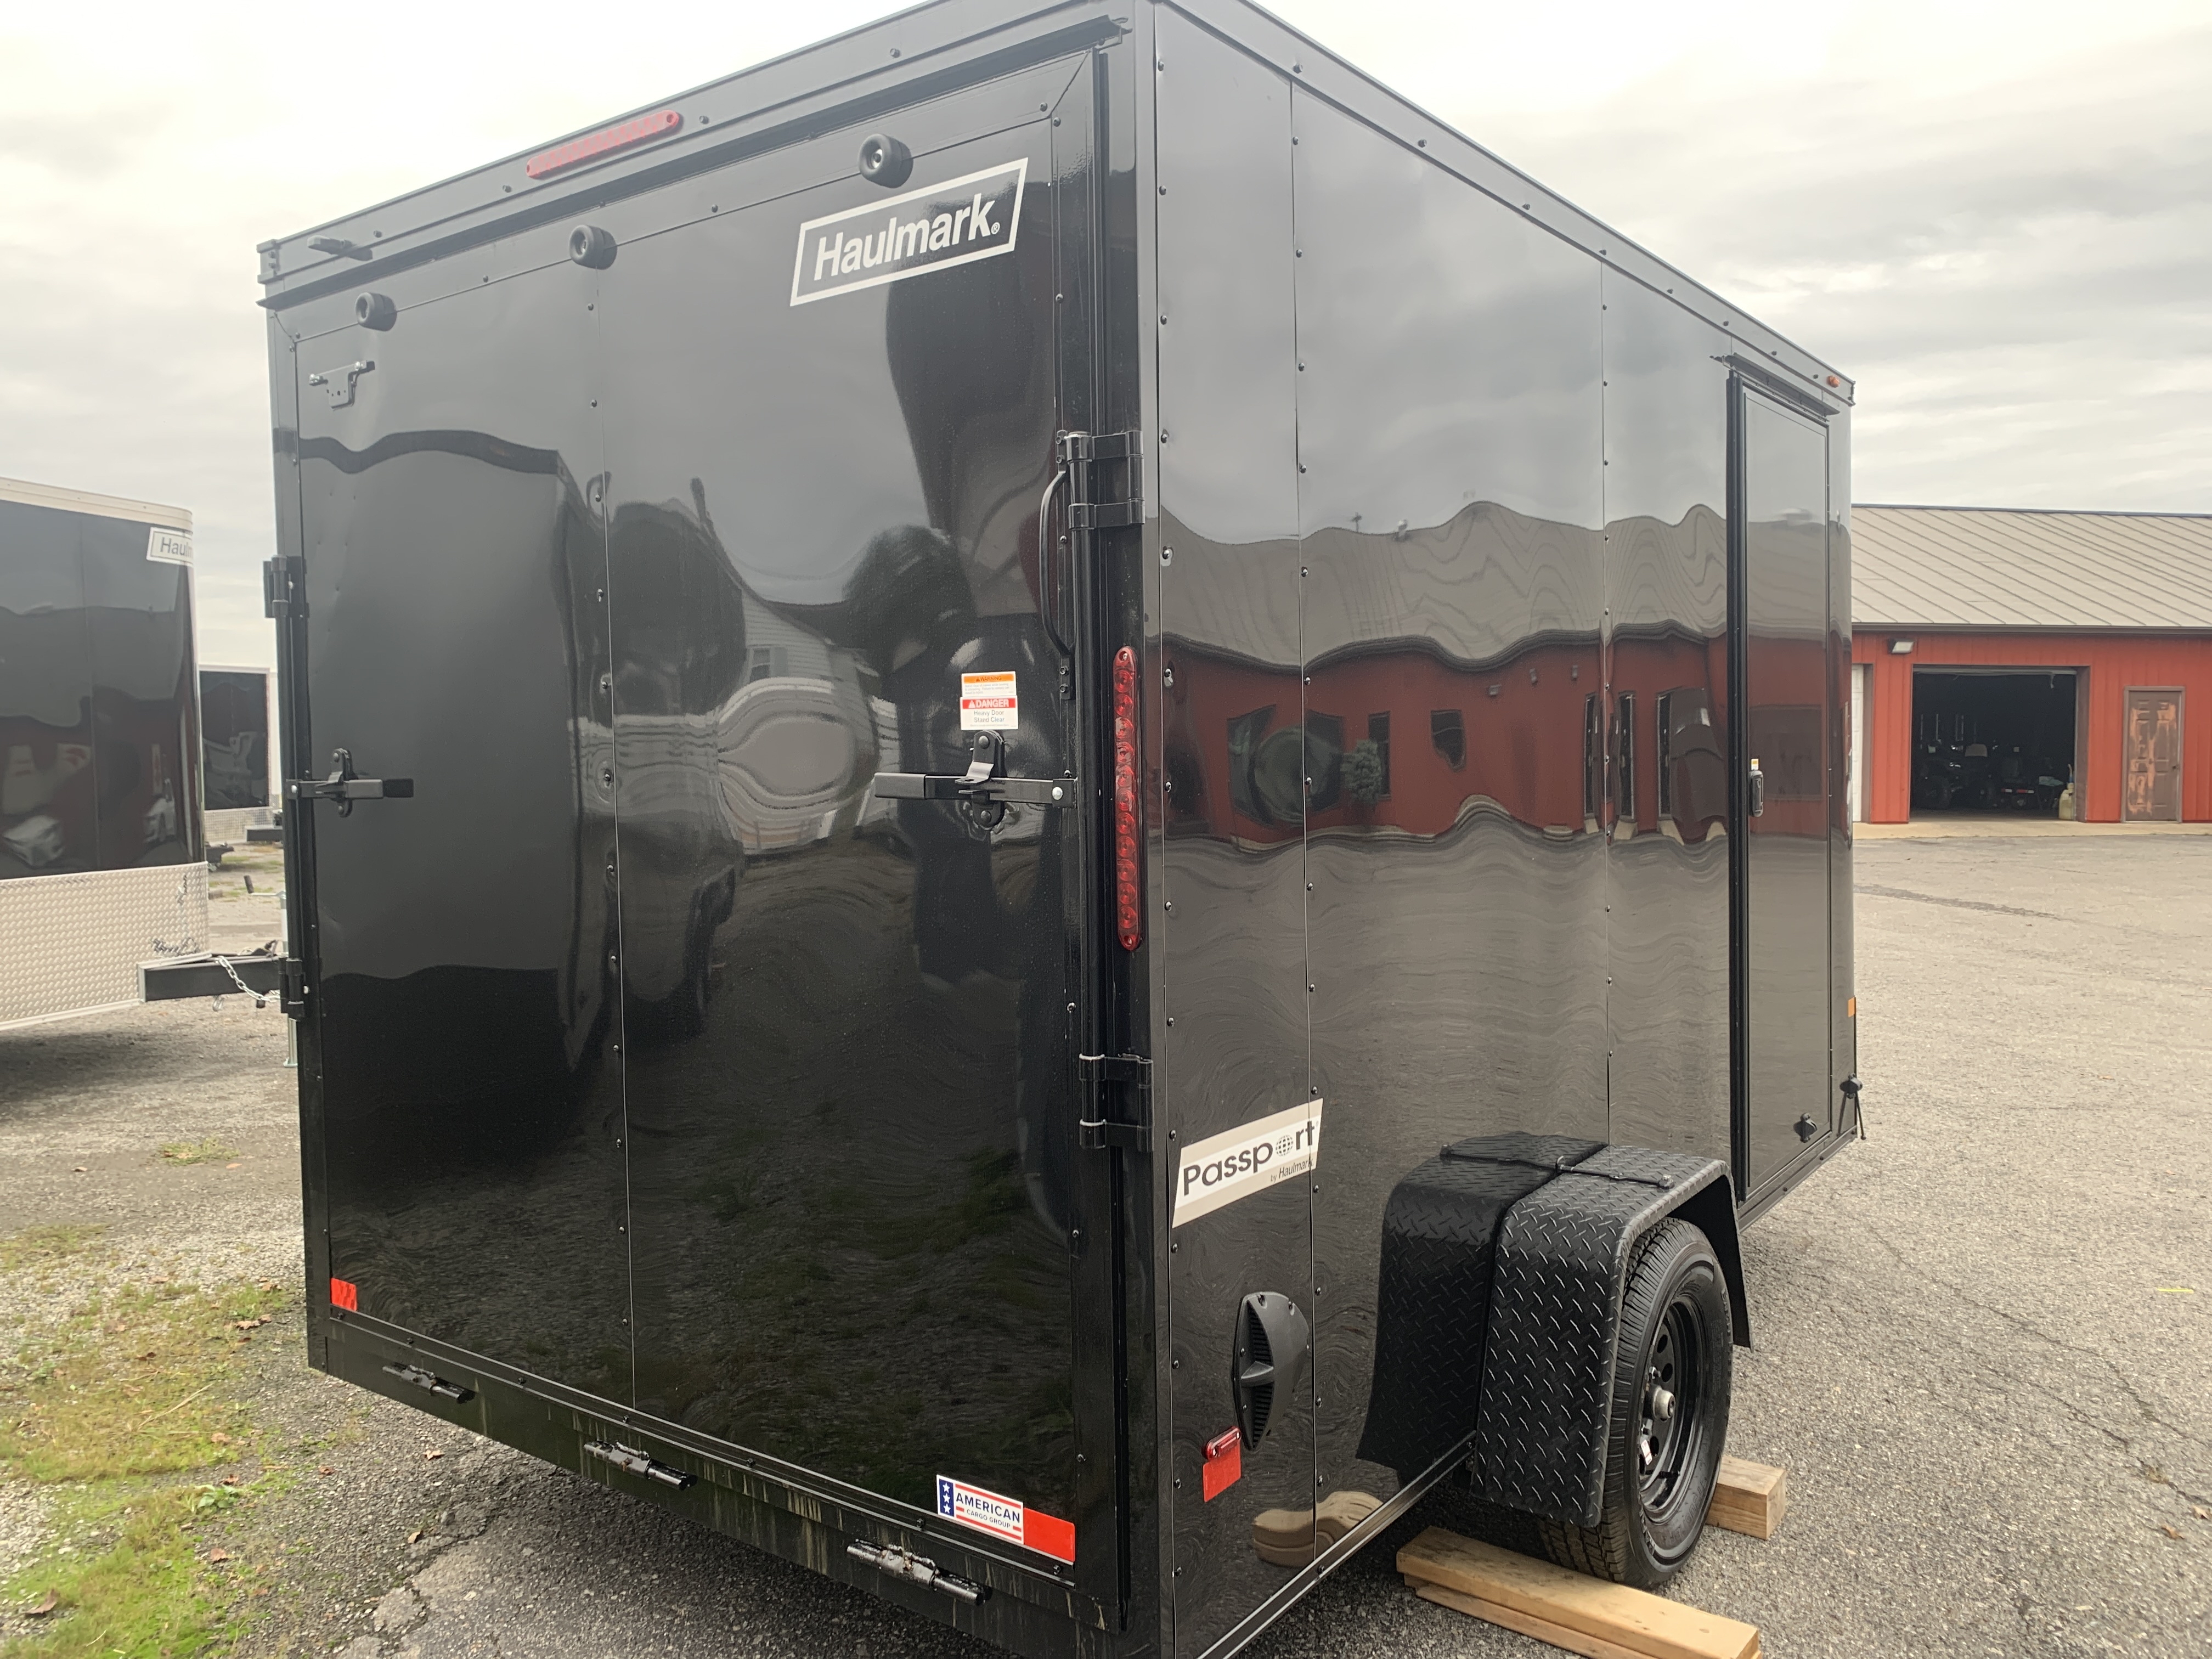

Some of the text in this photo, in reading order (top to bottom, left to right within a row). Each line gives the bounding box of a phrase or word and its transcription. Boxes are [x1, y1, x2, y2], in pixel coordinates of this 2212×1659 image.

[976, 699, 1009, 708] DANGER
[1271, 1175, 1277, 1183] by
[956, 1493, 1020, 1523] AMERICAN
[967, 1509, 1011, 1528] CARGO GROUP
